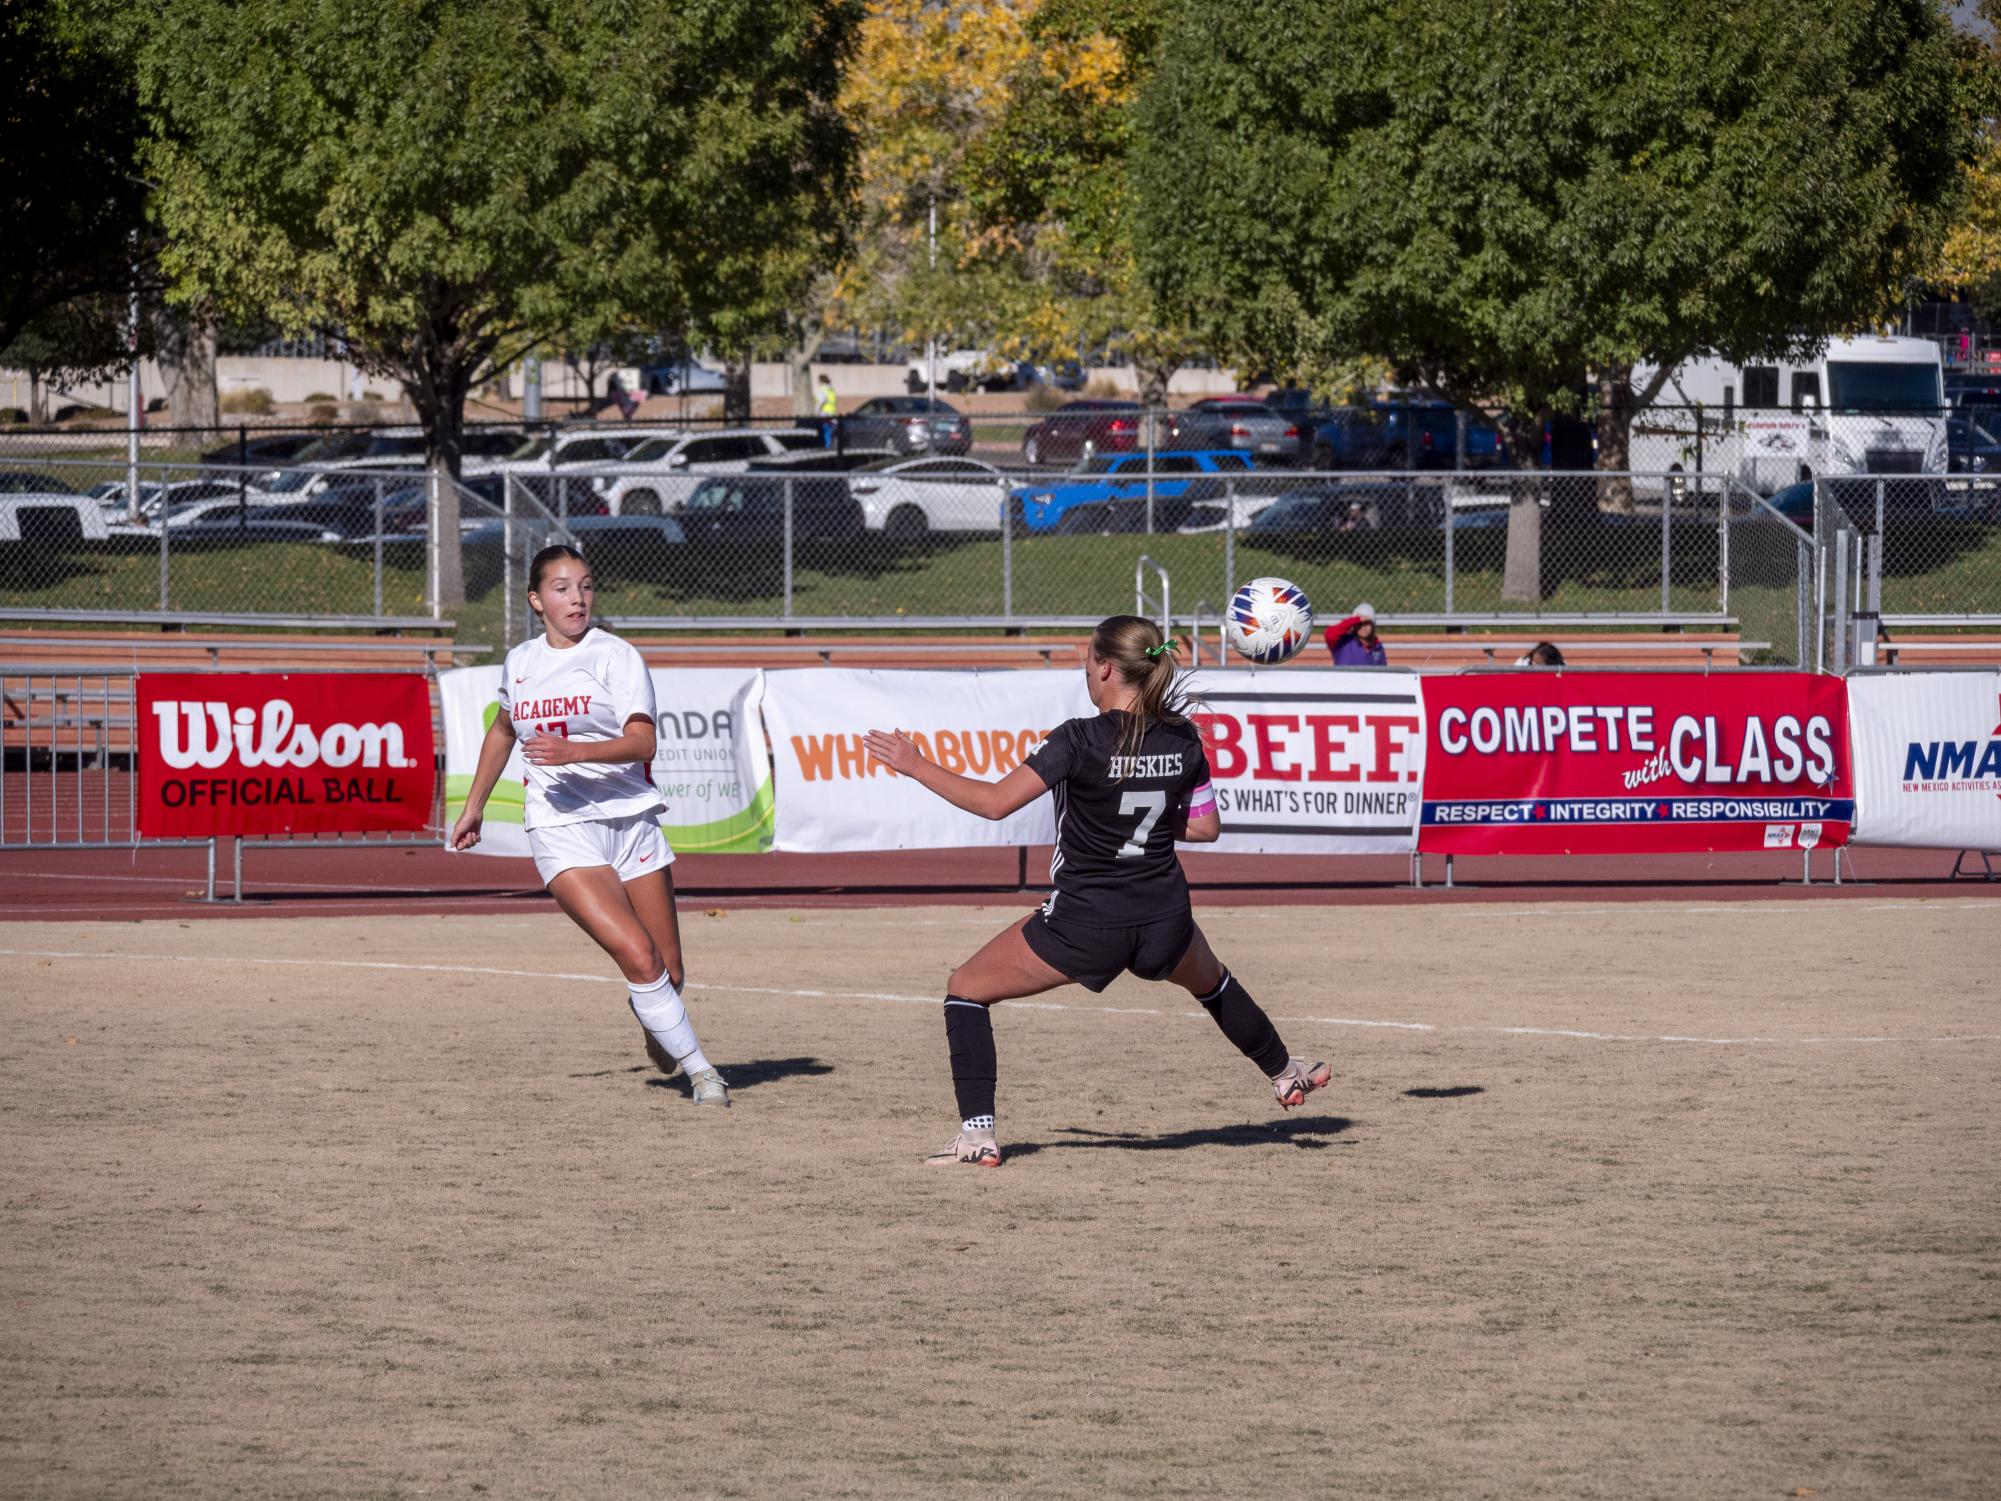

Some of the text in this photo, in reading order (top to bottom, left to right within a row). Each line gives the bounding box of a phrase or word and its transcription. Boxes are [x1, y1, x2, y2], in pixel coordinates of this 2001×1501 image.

[513, 695, 592, 721] ACADEMY
[535, 721, 569, 741] 7
[1438, 705, 1655, 755] COMPETE
[655, 748, 687, 761] EDIT
[1621, 715, 1834, 790] with CLASS
[1108, 753, 1183, 779] HUSKIES
[161, 776, 403, 808] OFFICIAL BALL
[696, 779, 713, 802] of
[1903, 782, 1919, 793] NEW
[1921, 782, 1949, 792] MEXICO
[1952, 780, 1990, 792] ACTIVITIES
[1234, 789, 1299, 813] WHAT'S
[1303, 791, 1337, 814] FOR
[1434, 802, 1832, 822] RESPECT INTEGRITY RESPONSIBILITY
[1116, 791, 1166, 859] 7
